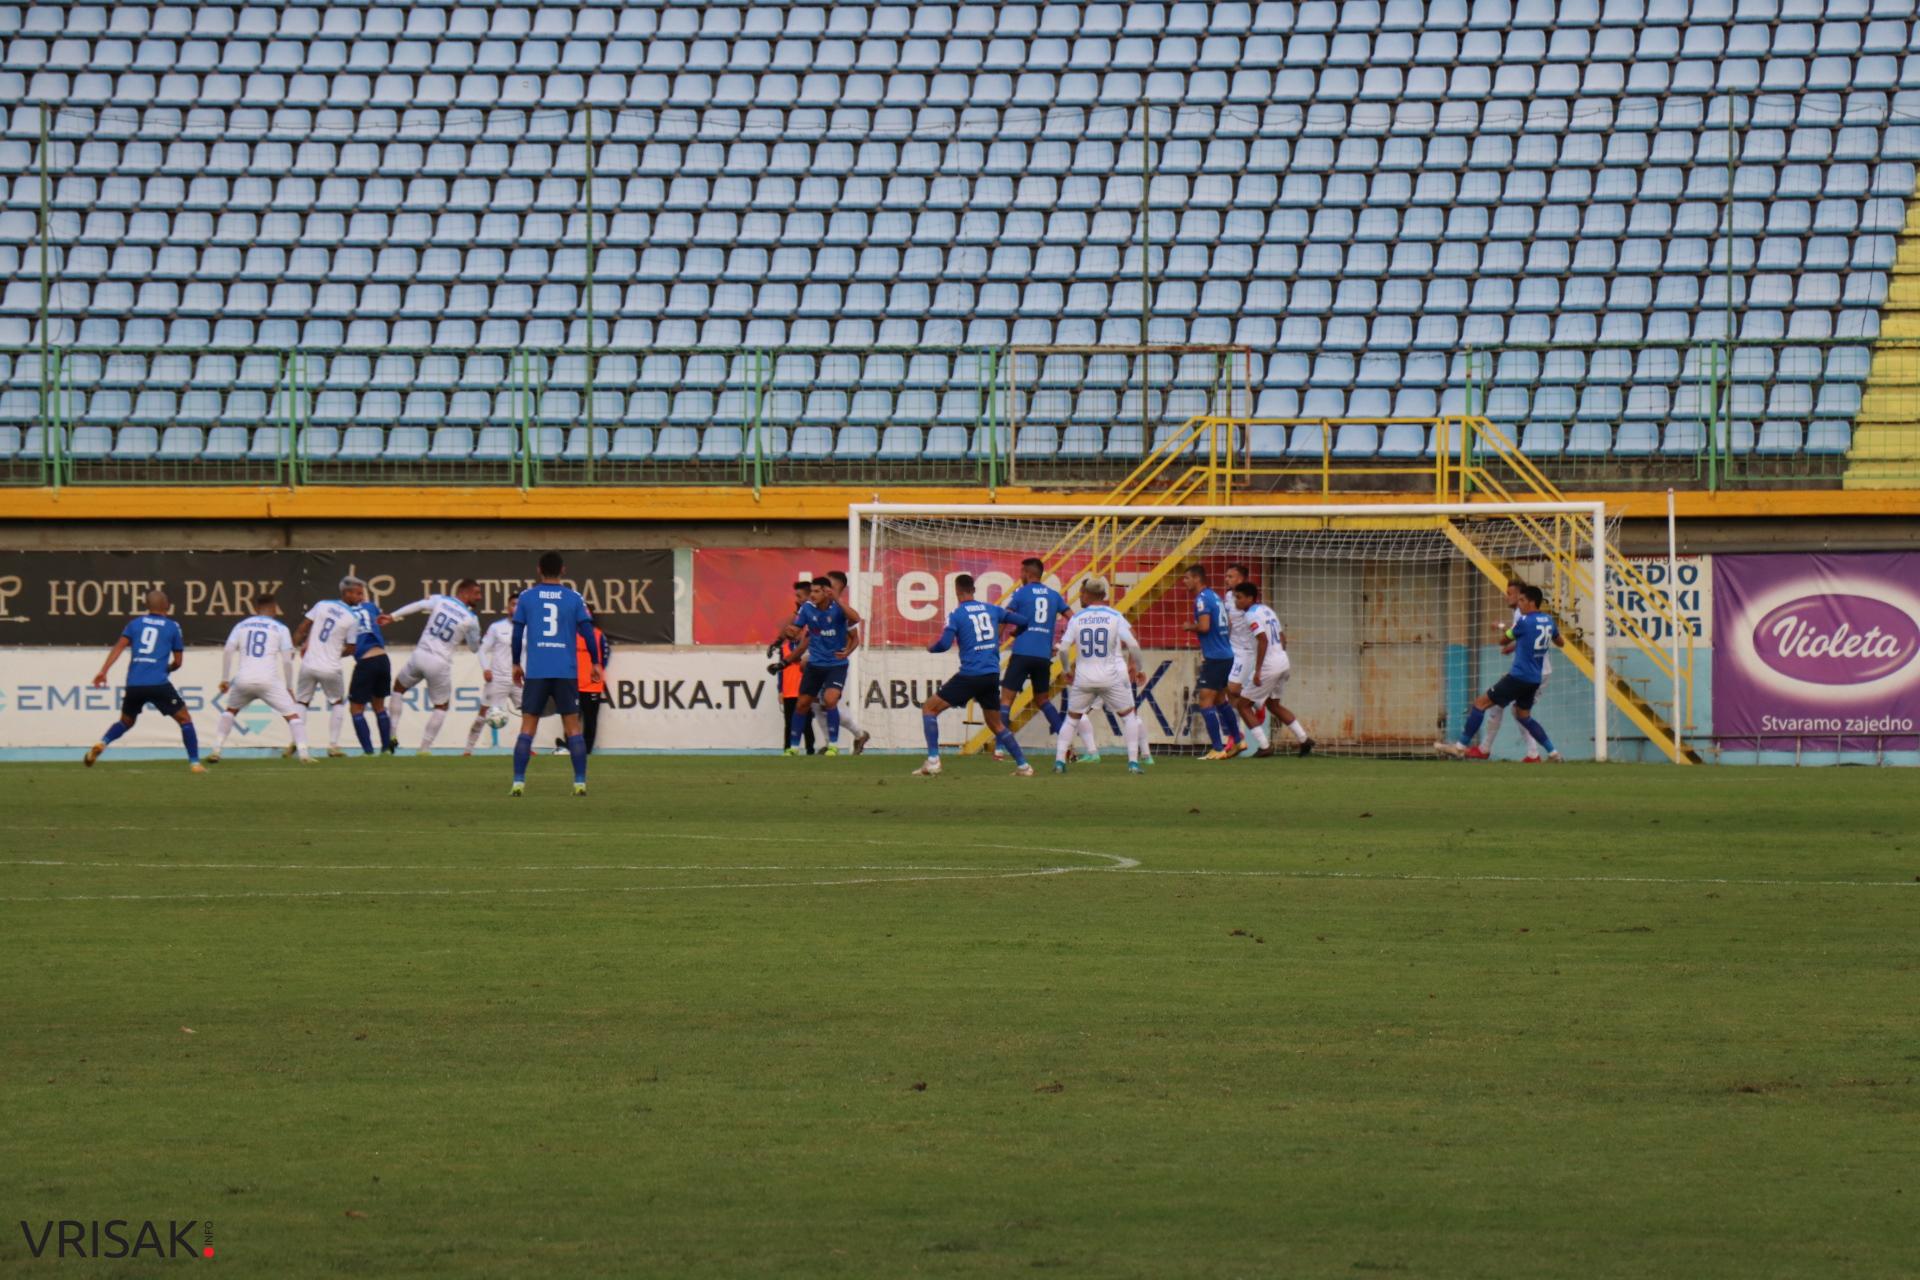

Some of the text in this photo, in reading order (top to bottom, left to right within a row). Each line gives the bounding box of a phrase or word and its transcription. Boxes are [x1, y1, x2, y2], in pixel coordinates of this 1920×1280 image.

[542, 602, 558, 637] 3
[1035, 597, 1048, 624] 8
[138, 626, 159, 654] 9
[319, 617, 335, 643] 8
[429, 611, 458, 643] 95
[968, 612, 995, 642] 19
[1772, 615, 1901, 658] Violeta
[246, 630, 267, 658] 18
[1080, 628, 1109, 658] 99
[17, 685, 204, 711] EMES
[598, 680, 766, 710] ABUKA.TV
[1761, 714, 1913, 734] Stvaramo zajedno
